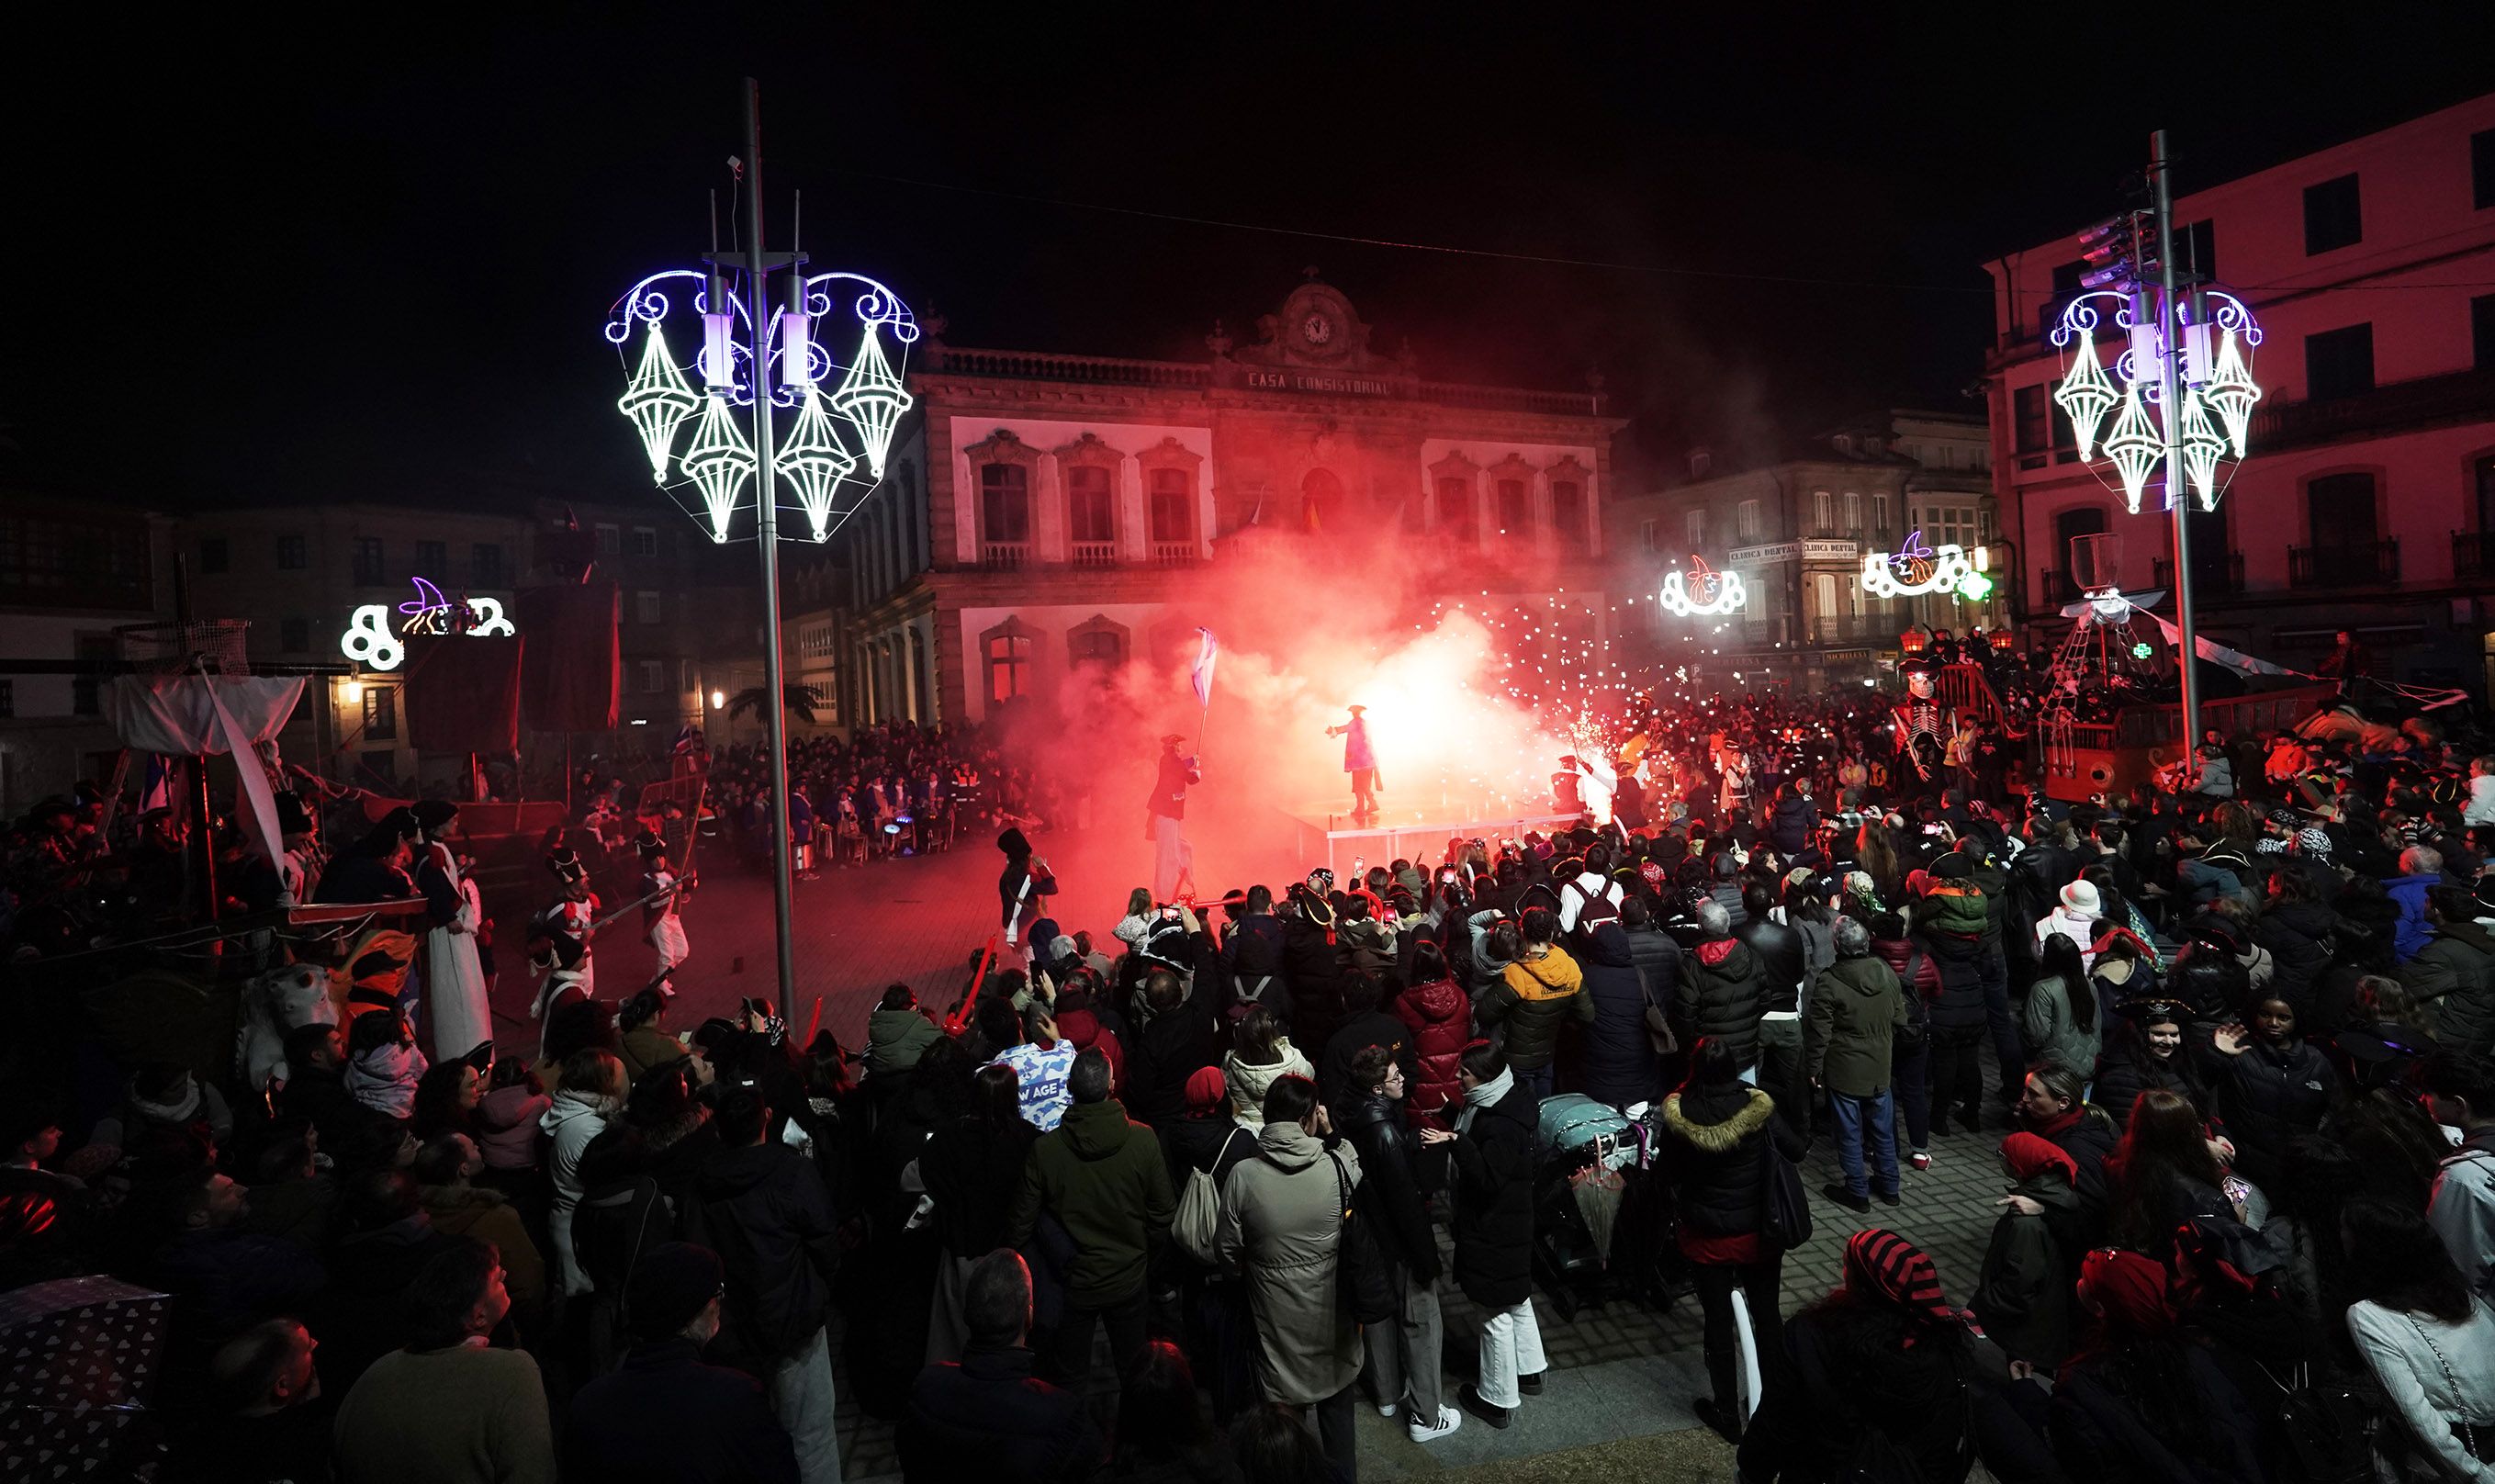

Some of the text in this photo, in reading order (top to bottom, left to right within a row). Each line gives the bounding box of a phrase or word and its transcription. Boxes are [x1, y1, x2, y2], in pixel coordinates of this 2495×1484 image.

[1249, 373, 1389, 394] CASA CONSISTORIAL
[1765, 545, 1797, 556] DENTAL
[1830, 544, 1856, 552] DENTAL
[1032, 1083, 1058, 1098] AGE
